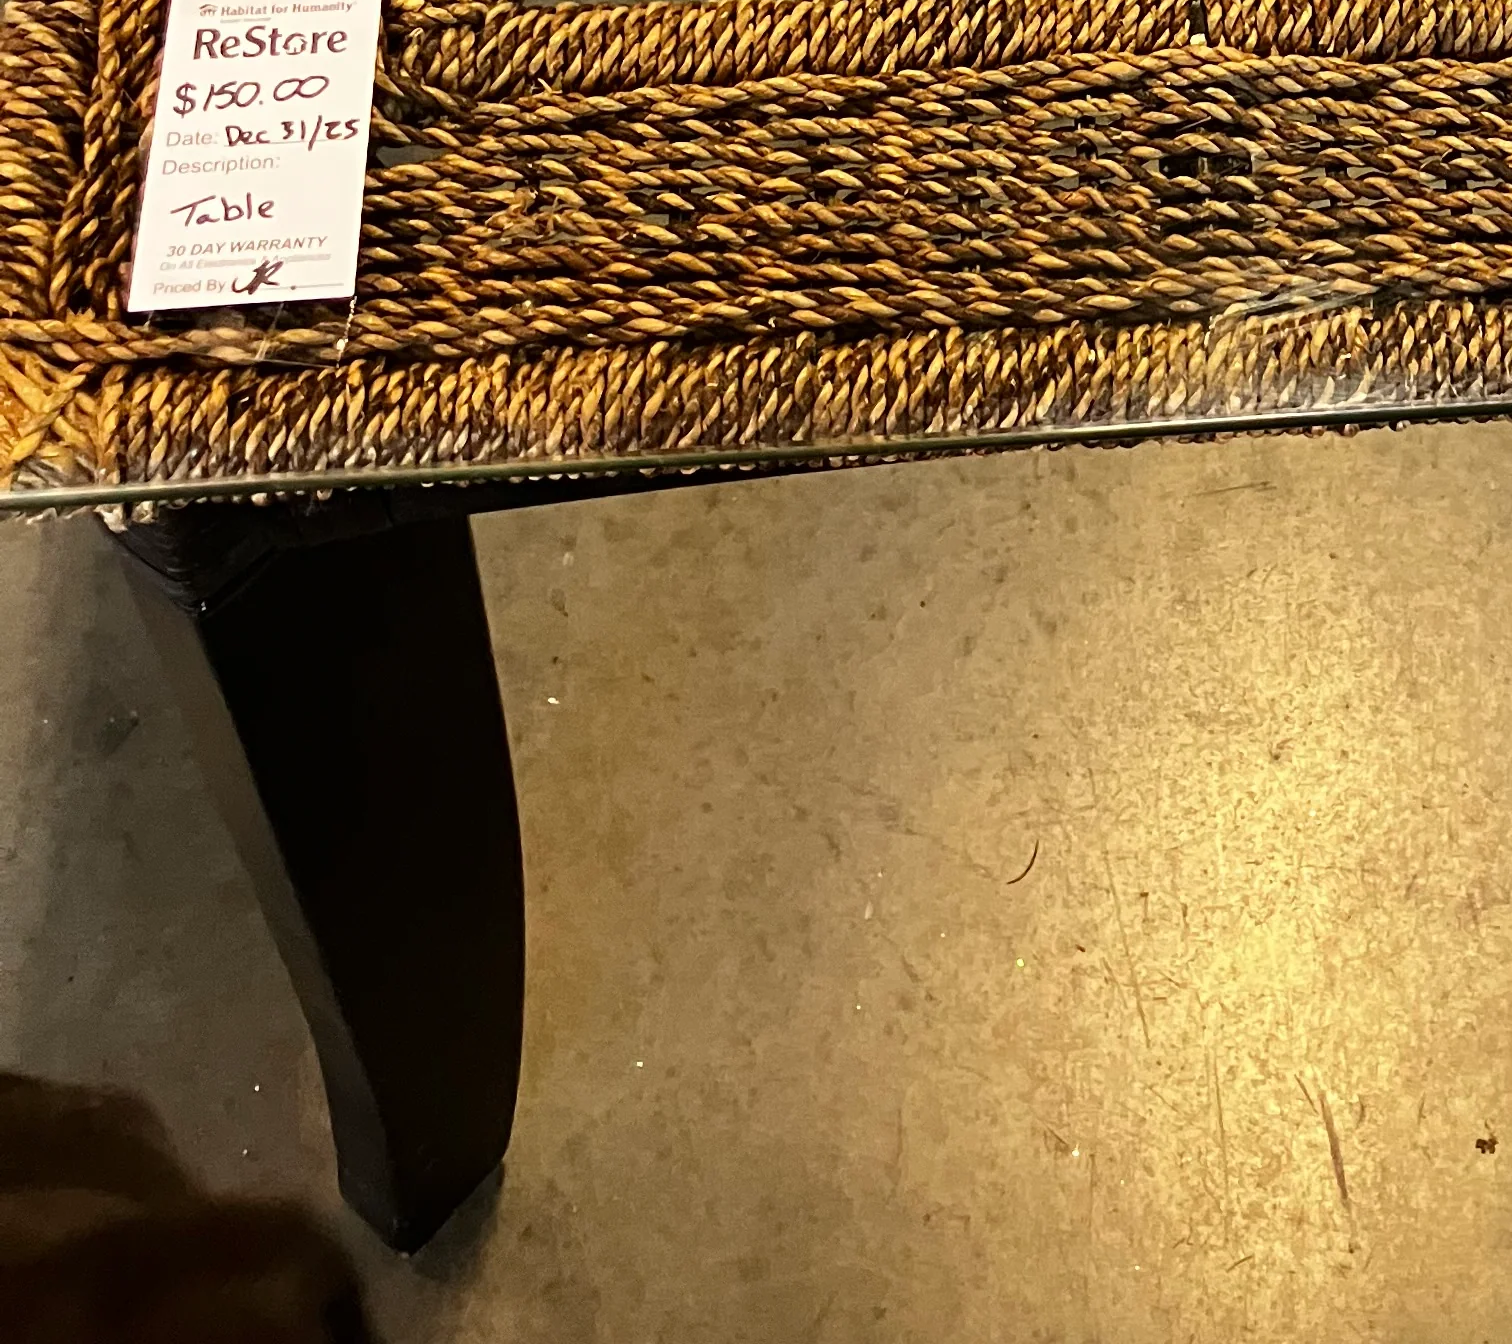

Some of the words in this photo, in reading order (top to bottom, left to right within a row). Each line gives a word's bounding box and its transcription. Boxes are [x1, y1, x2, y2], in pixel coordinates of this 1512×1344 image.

[220, 5, 268, 17] Habitat
[271, 4, 289, 15] for
[292, 1, 354, 14] Humanity
[193, 25, 348, 60] ReStore
[173, 75, 330, 119] $150.00
[166, 131, 219, 148] Date:
[225, 125, 271, 147] Dec
[281, 114, 361, 152] 31/25
[162, 156, 281, 176] Description:
[170, 192, 275, 227] Table
[166, 245, 186, 258] 30
[190, 242, 226, 256] DAY
[230, 236, 328, 253] WARRANTY
[153, 280, 202, 295] Priced
